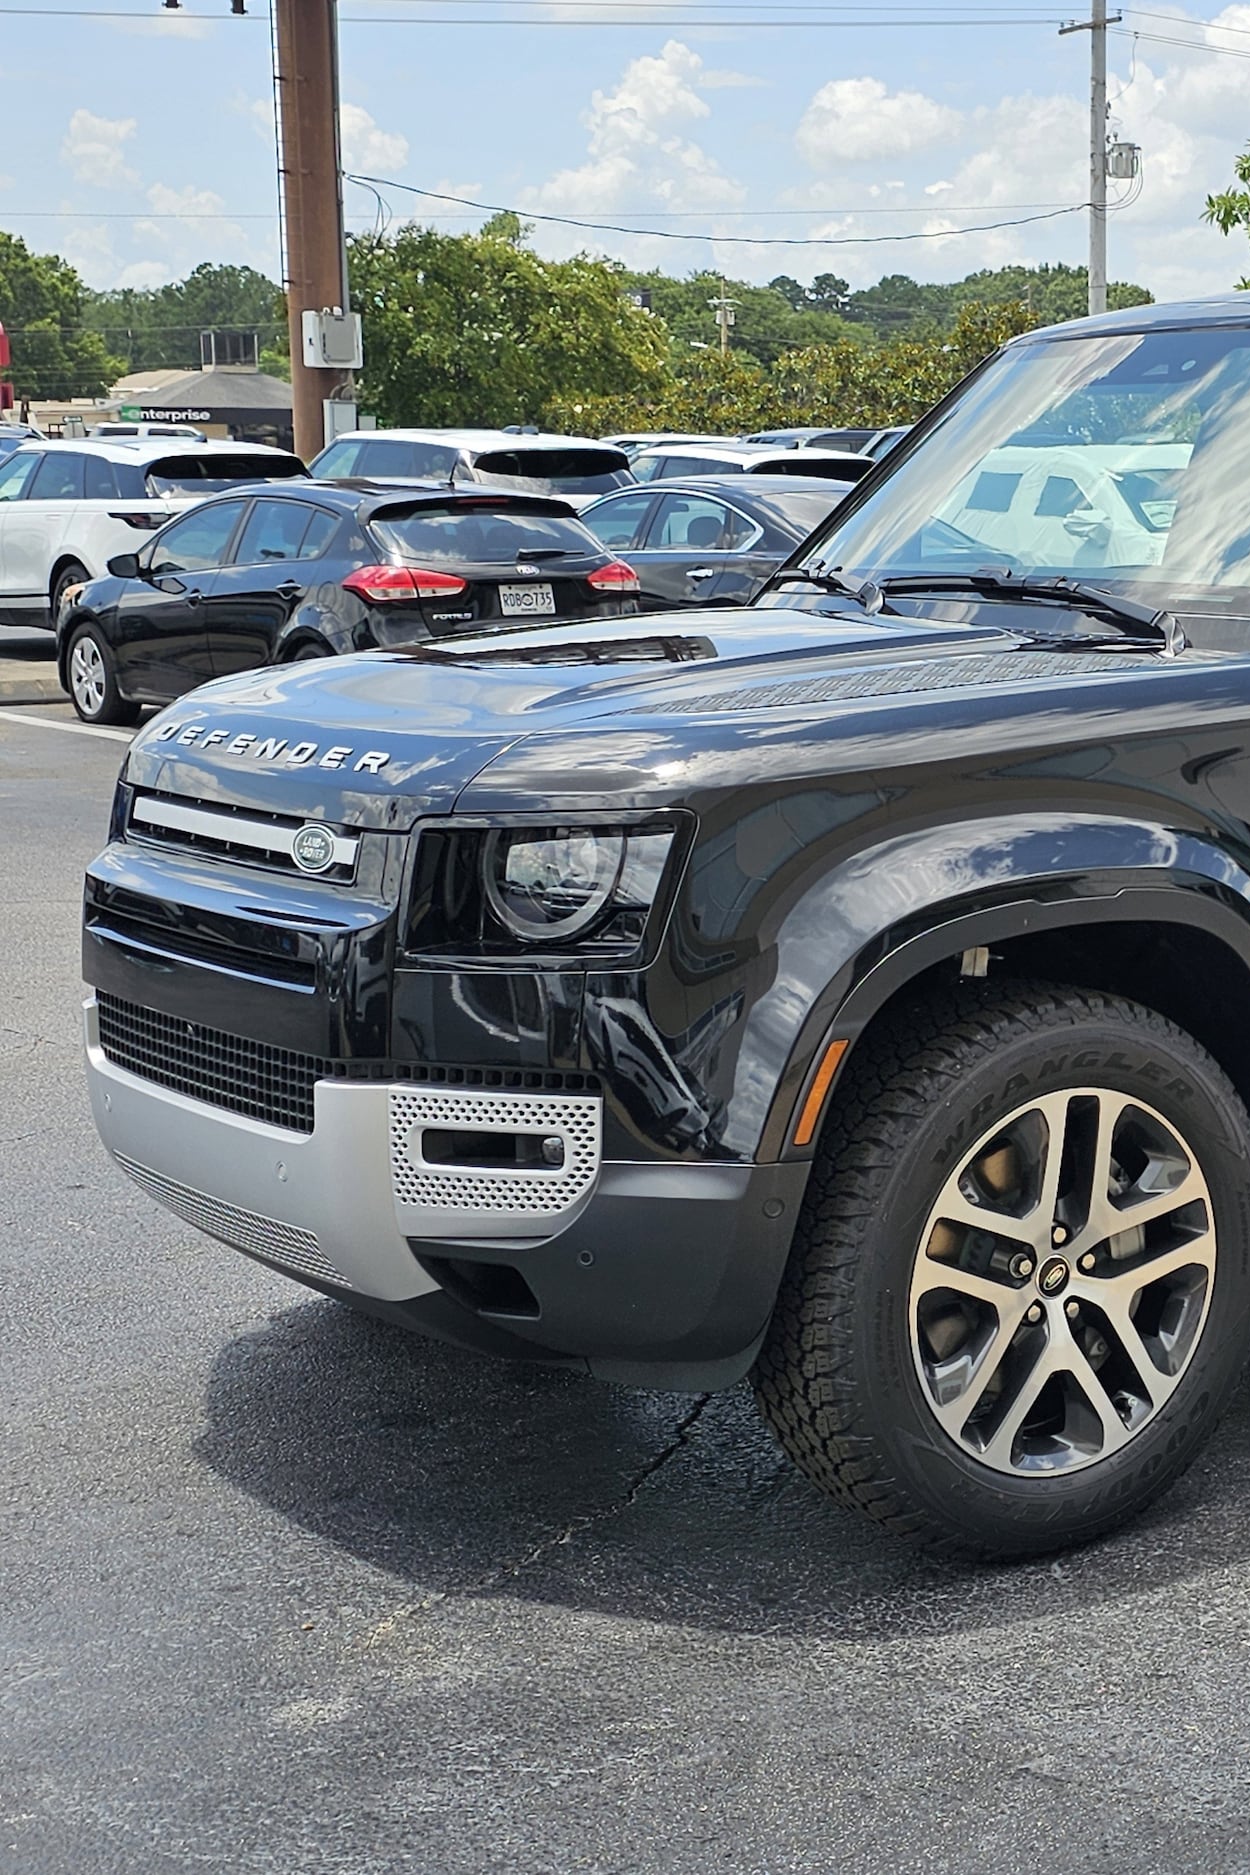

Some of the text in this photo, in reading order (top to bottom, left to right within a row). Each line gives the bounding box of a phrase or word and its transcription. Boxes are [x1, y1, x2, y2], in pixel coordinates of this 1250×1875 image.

[124, 409, 211, 422] enterprise
[157, 722, 391, 774] DEFENDER
[931, 1050, 1195, 1166] WRANGLER
